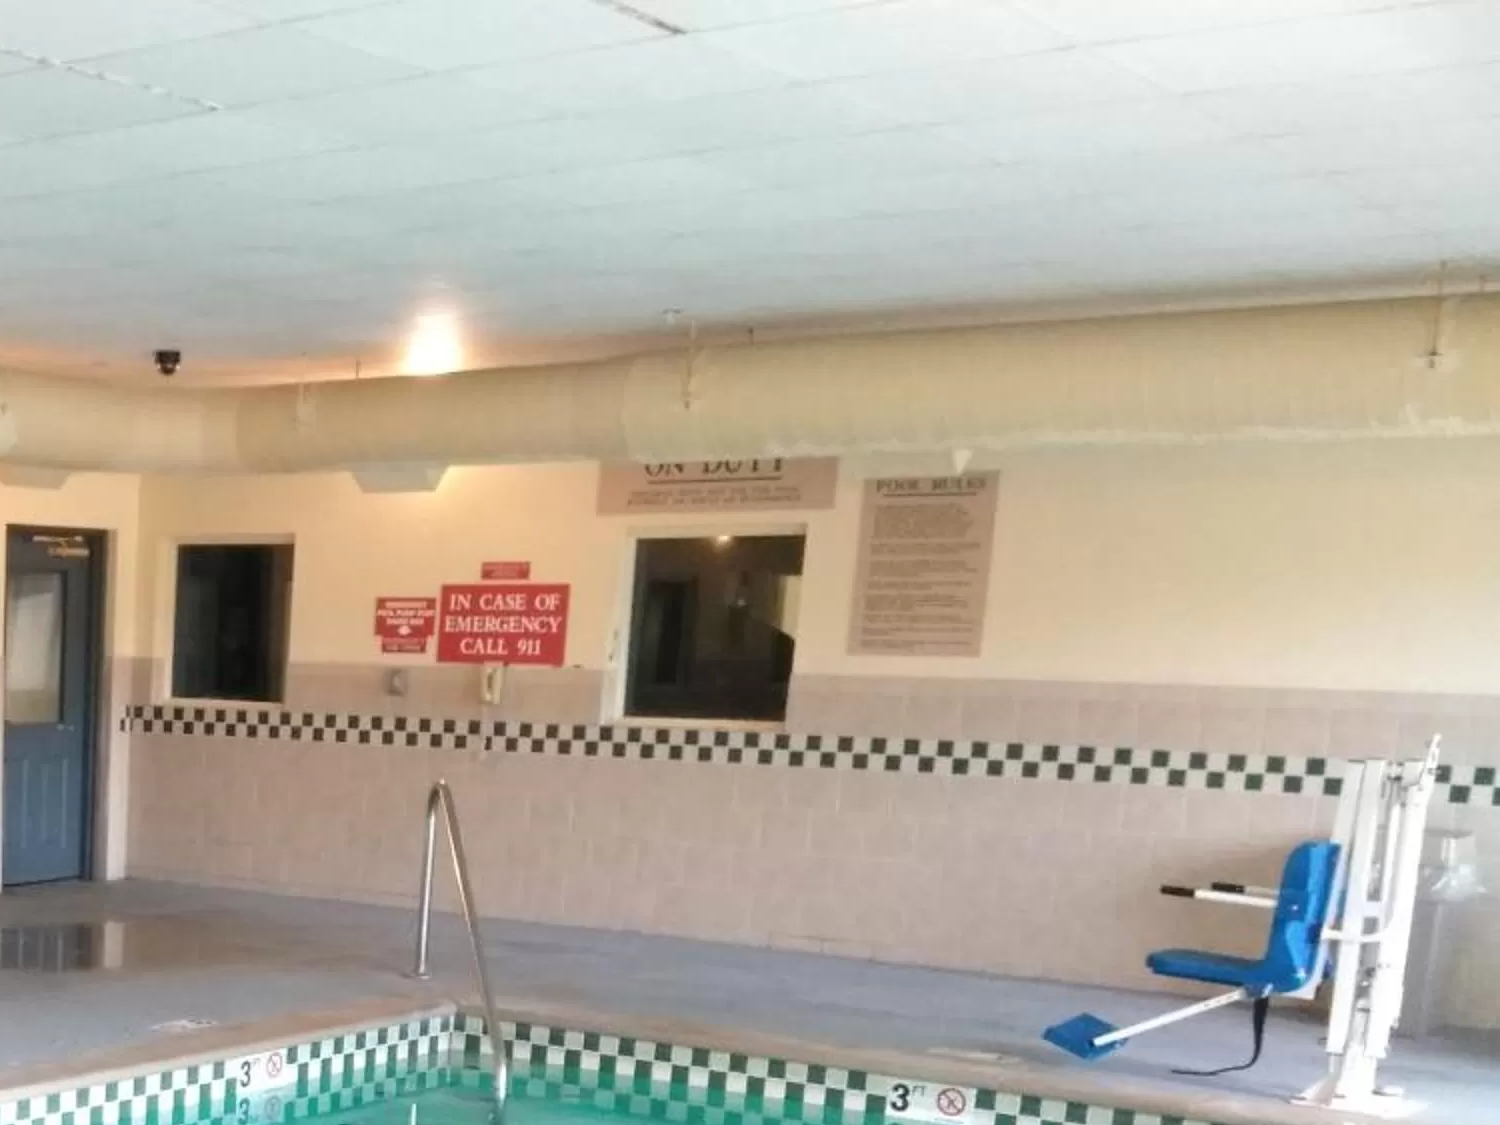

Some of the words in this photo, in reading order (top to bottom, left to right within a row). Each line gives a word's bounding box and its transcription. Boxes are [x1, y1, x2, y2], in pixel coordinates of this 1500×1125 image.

[450, 593, 471, 610] IN
[479, 593, 526, 611] CASE
[534, 593, 561, 610] OF
[444, 615, 562, 633] EMERGENCY
[459, 638, 509, 655] CALL
[517, 639, 541, 655] 911
[240, 1060, 251, 1088] 3
[891, 1083, 909, 1112] 3
